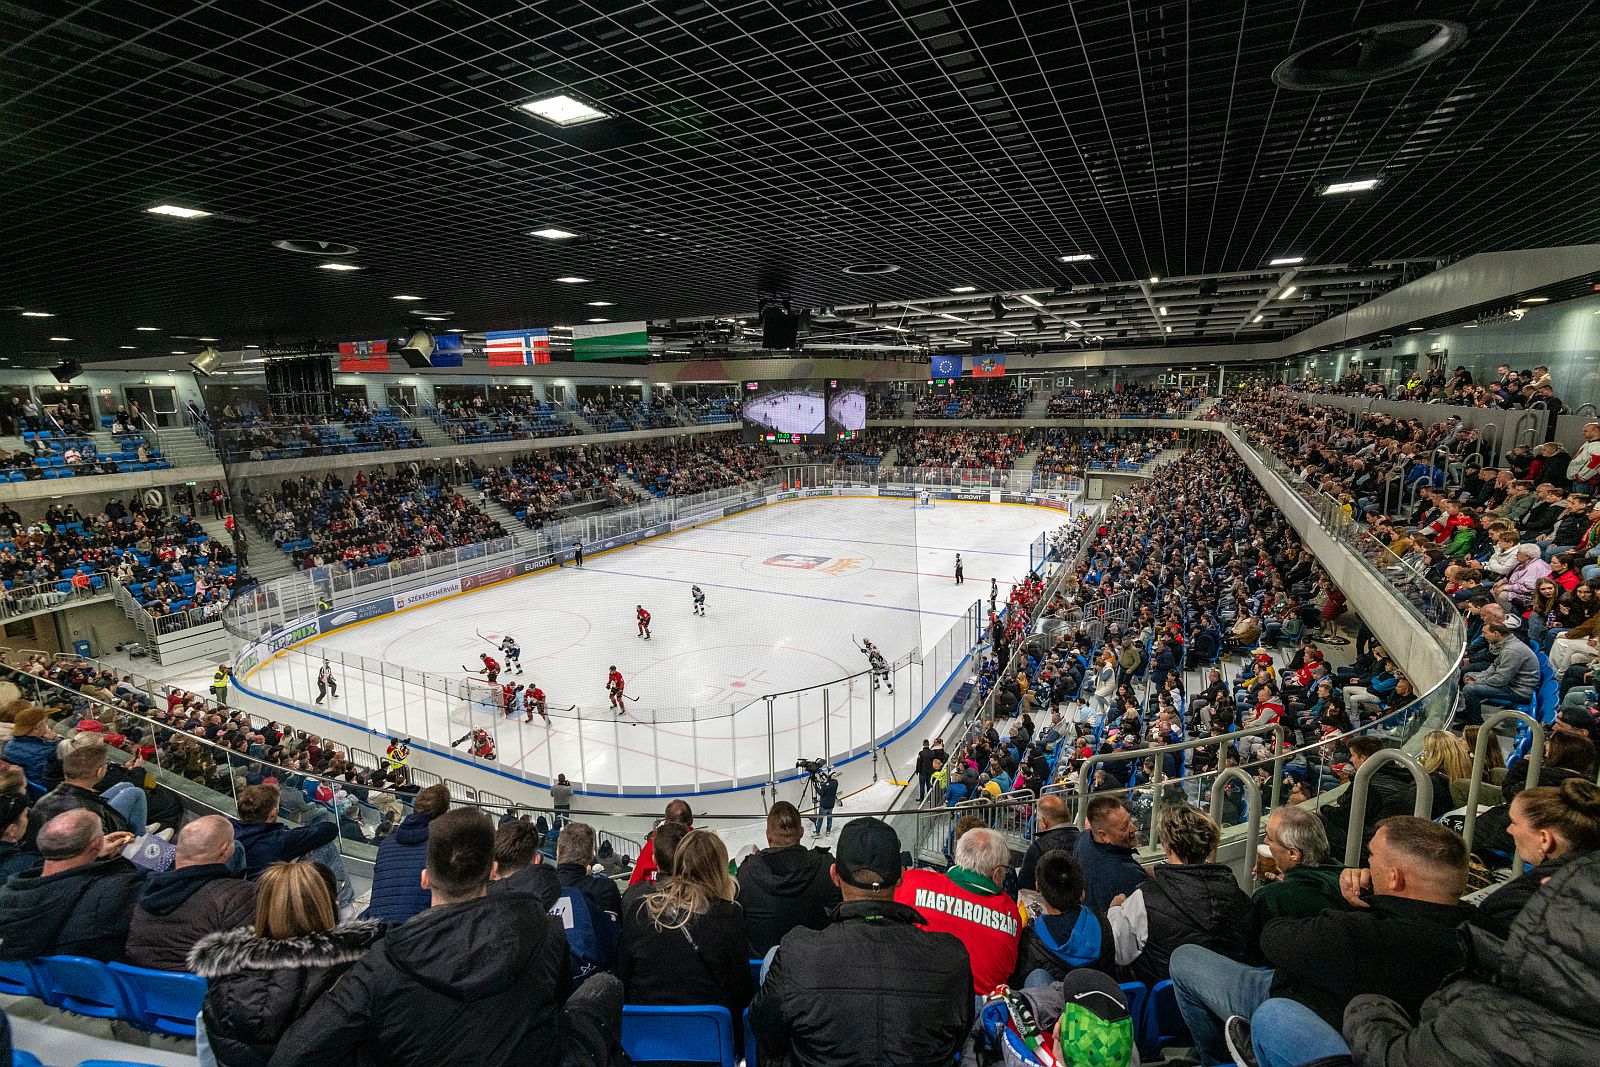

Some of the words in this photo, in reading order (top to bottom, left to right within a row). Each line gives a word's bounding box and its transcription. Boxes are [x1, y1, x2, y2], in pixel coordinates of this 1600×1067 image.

[803, 434, 807, 442] 1
[524, 556, 554, 571] EUROVIT
[407, 584, 459, 604] SZÉKESFEHÉRVÁR
[915, 888, 1017, 937] MAGYARORSZÁG
